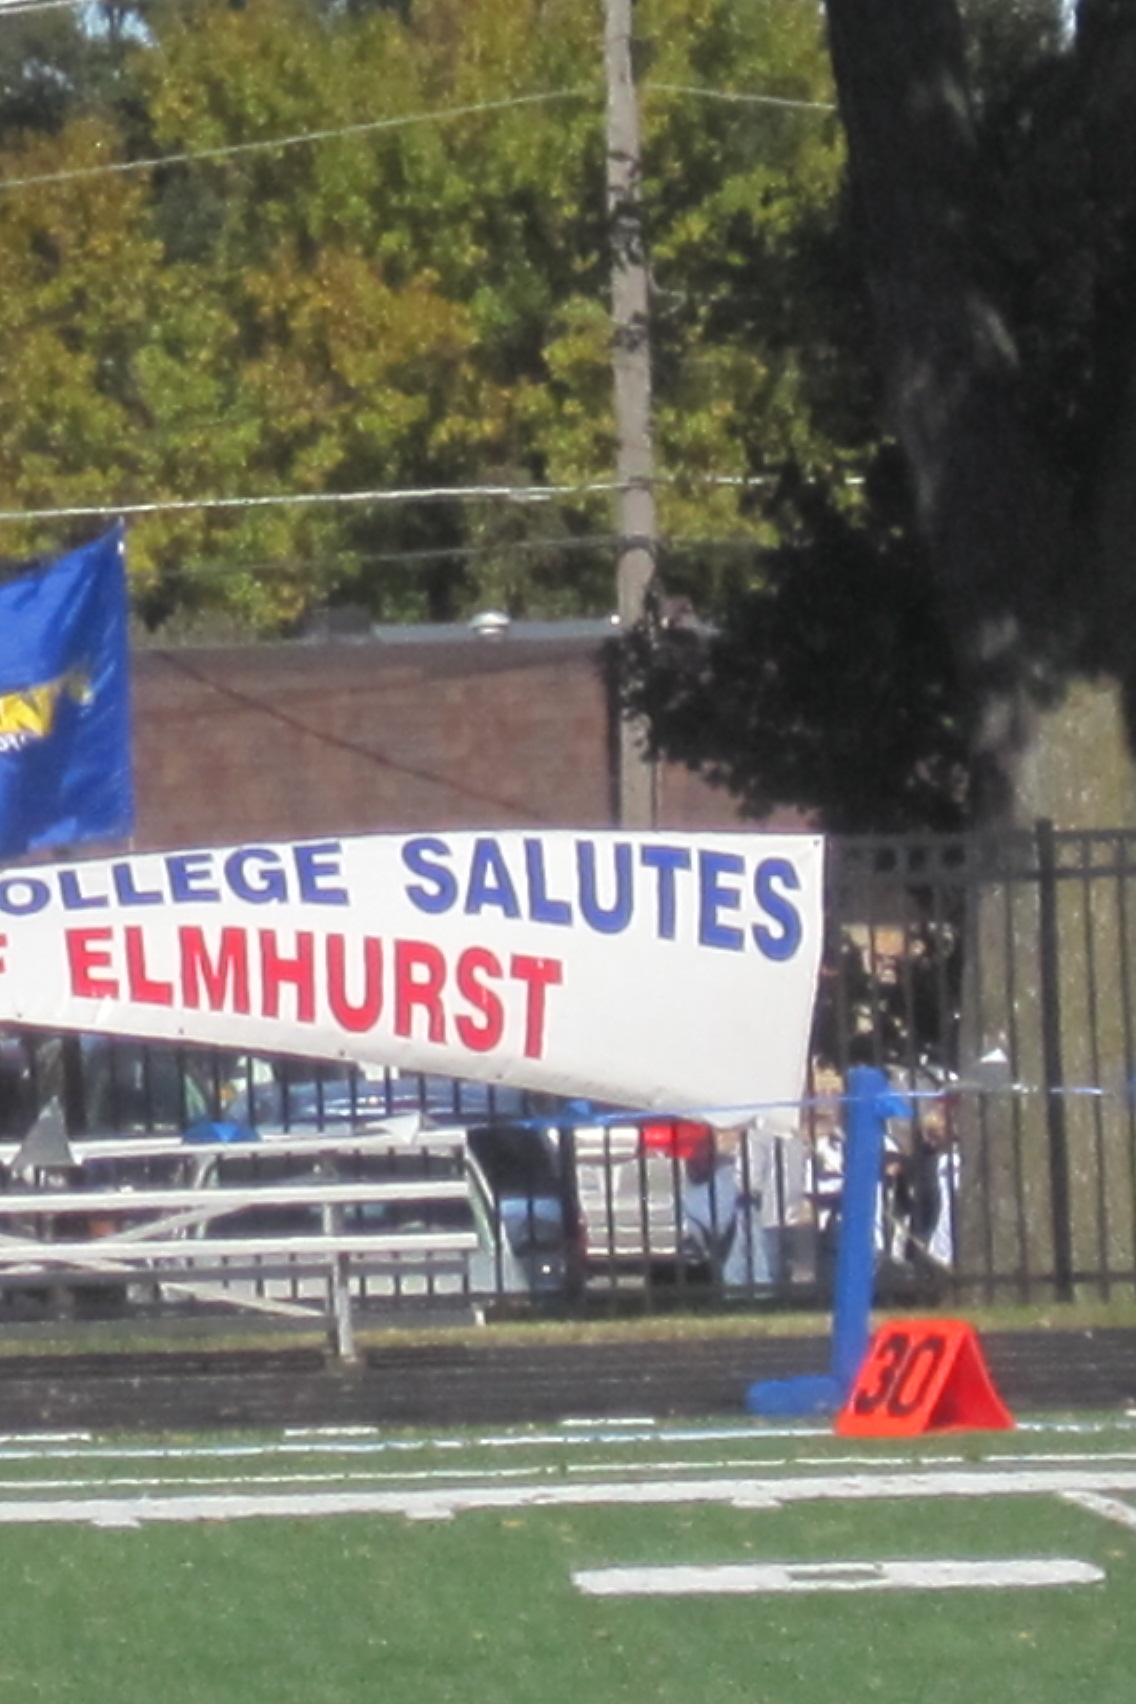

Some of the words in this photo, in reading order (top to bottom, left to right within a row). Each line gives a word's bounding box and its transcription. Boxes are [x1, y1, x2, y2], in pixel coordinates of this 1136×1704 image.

[400, 836, 803, 963] SALUTES
[64, 924, 563, 1060] ELMHURST
[853, 1332, 947, 1418] 30
